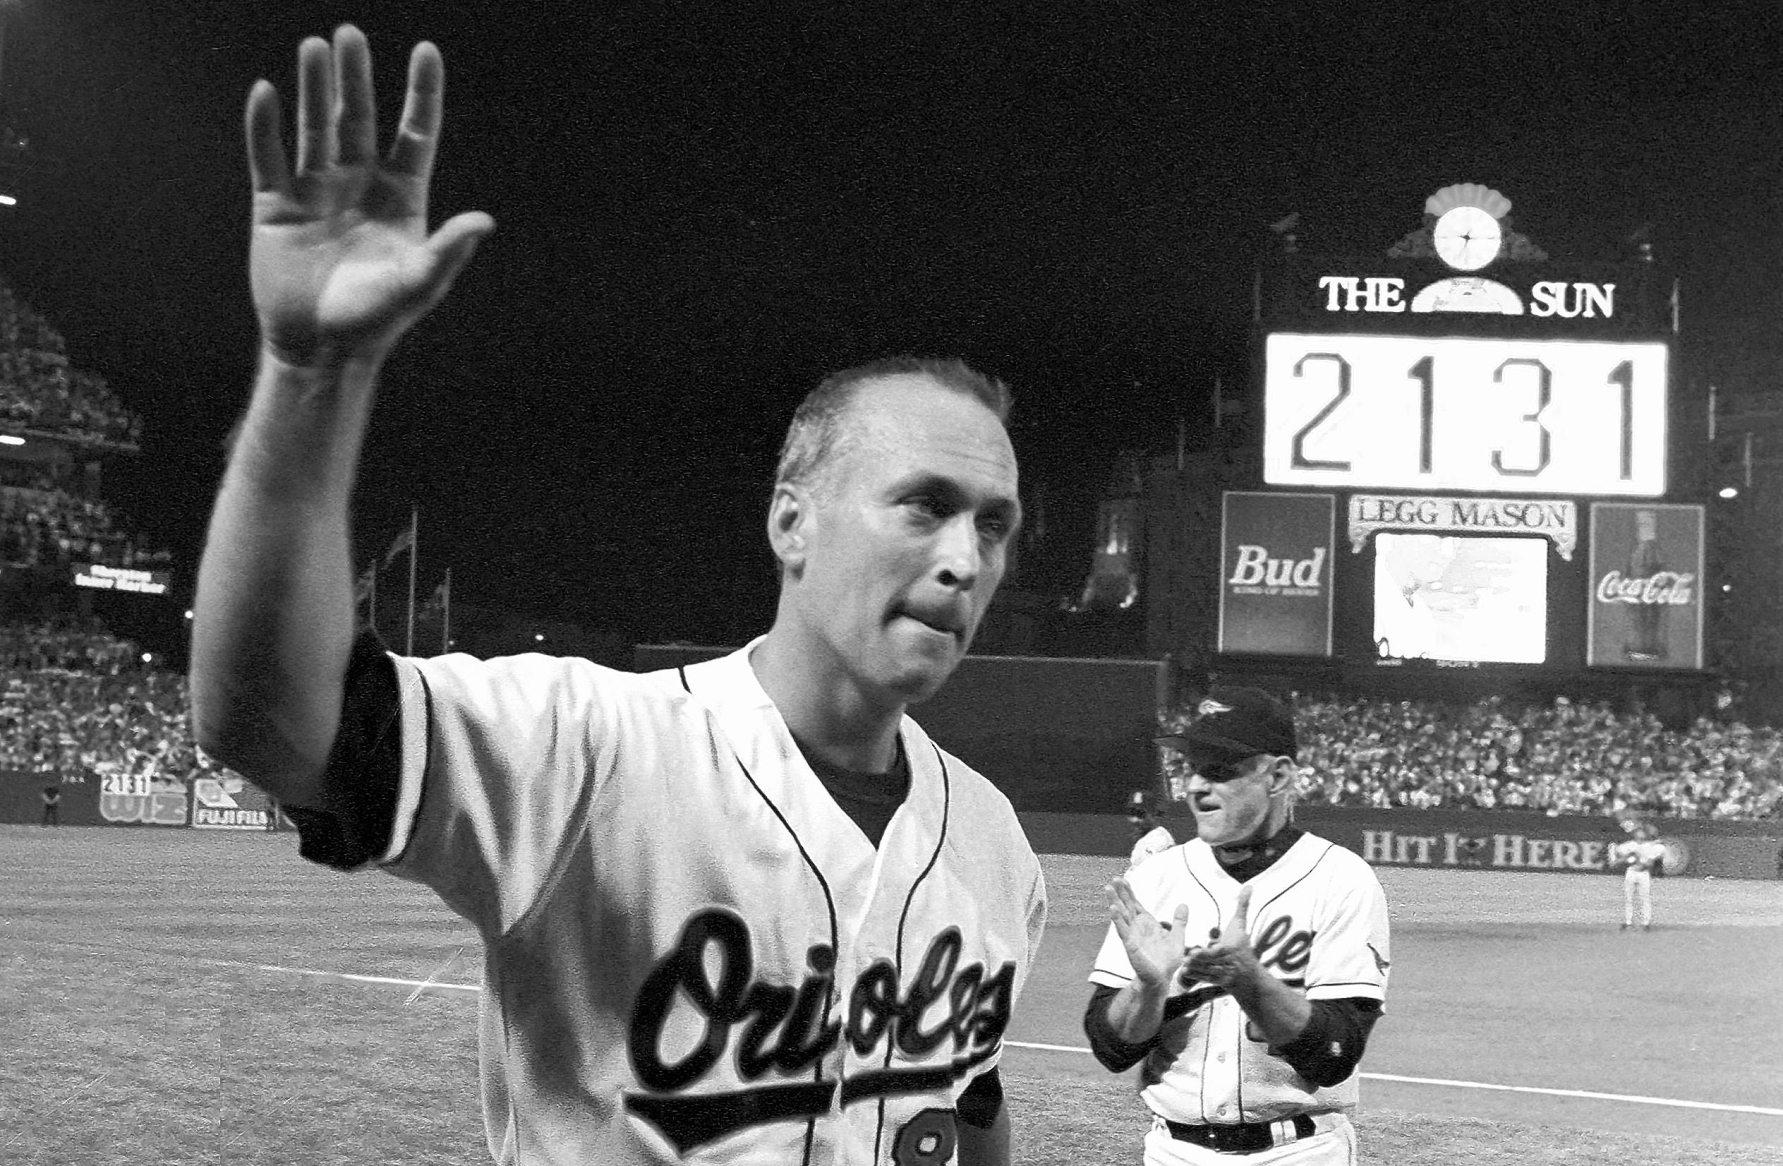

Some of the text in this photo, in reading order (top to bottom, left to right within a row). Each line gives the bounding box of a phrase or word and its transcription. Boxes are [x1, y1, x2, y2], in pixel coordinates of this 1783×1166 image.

[1318, 275, 1616, 319] THE SUN
[1290, 351, 1634, 481] 2131
[1357, 498, 1569, 528] LEGG MASON
[1228, 544, 1327, 588] Bud
[1362, 829, 1437, 864] HIT
[626, 906, 1017, 1095] Orioles
